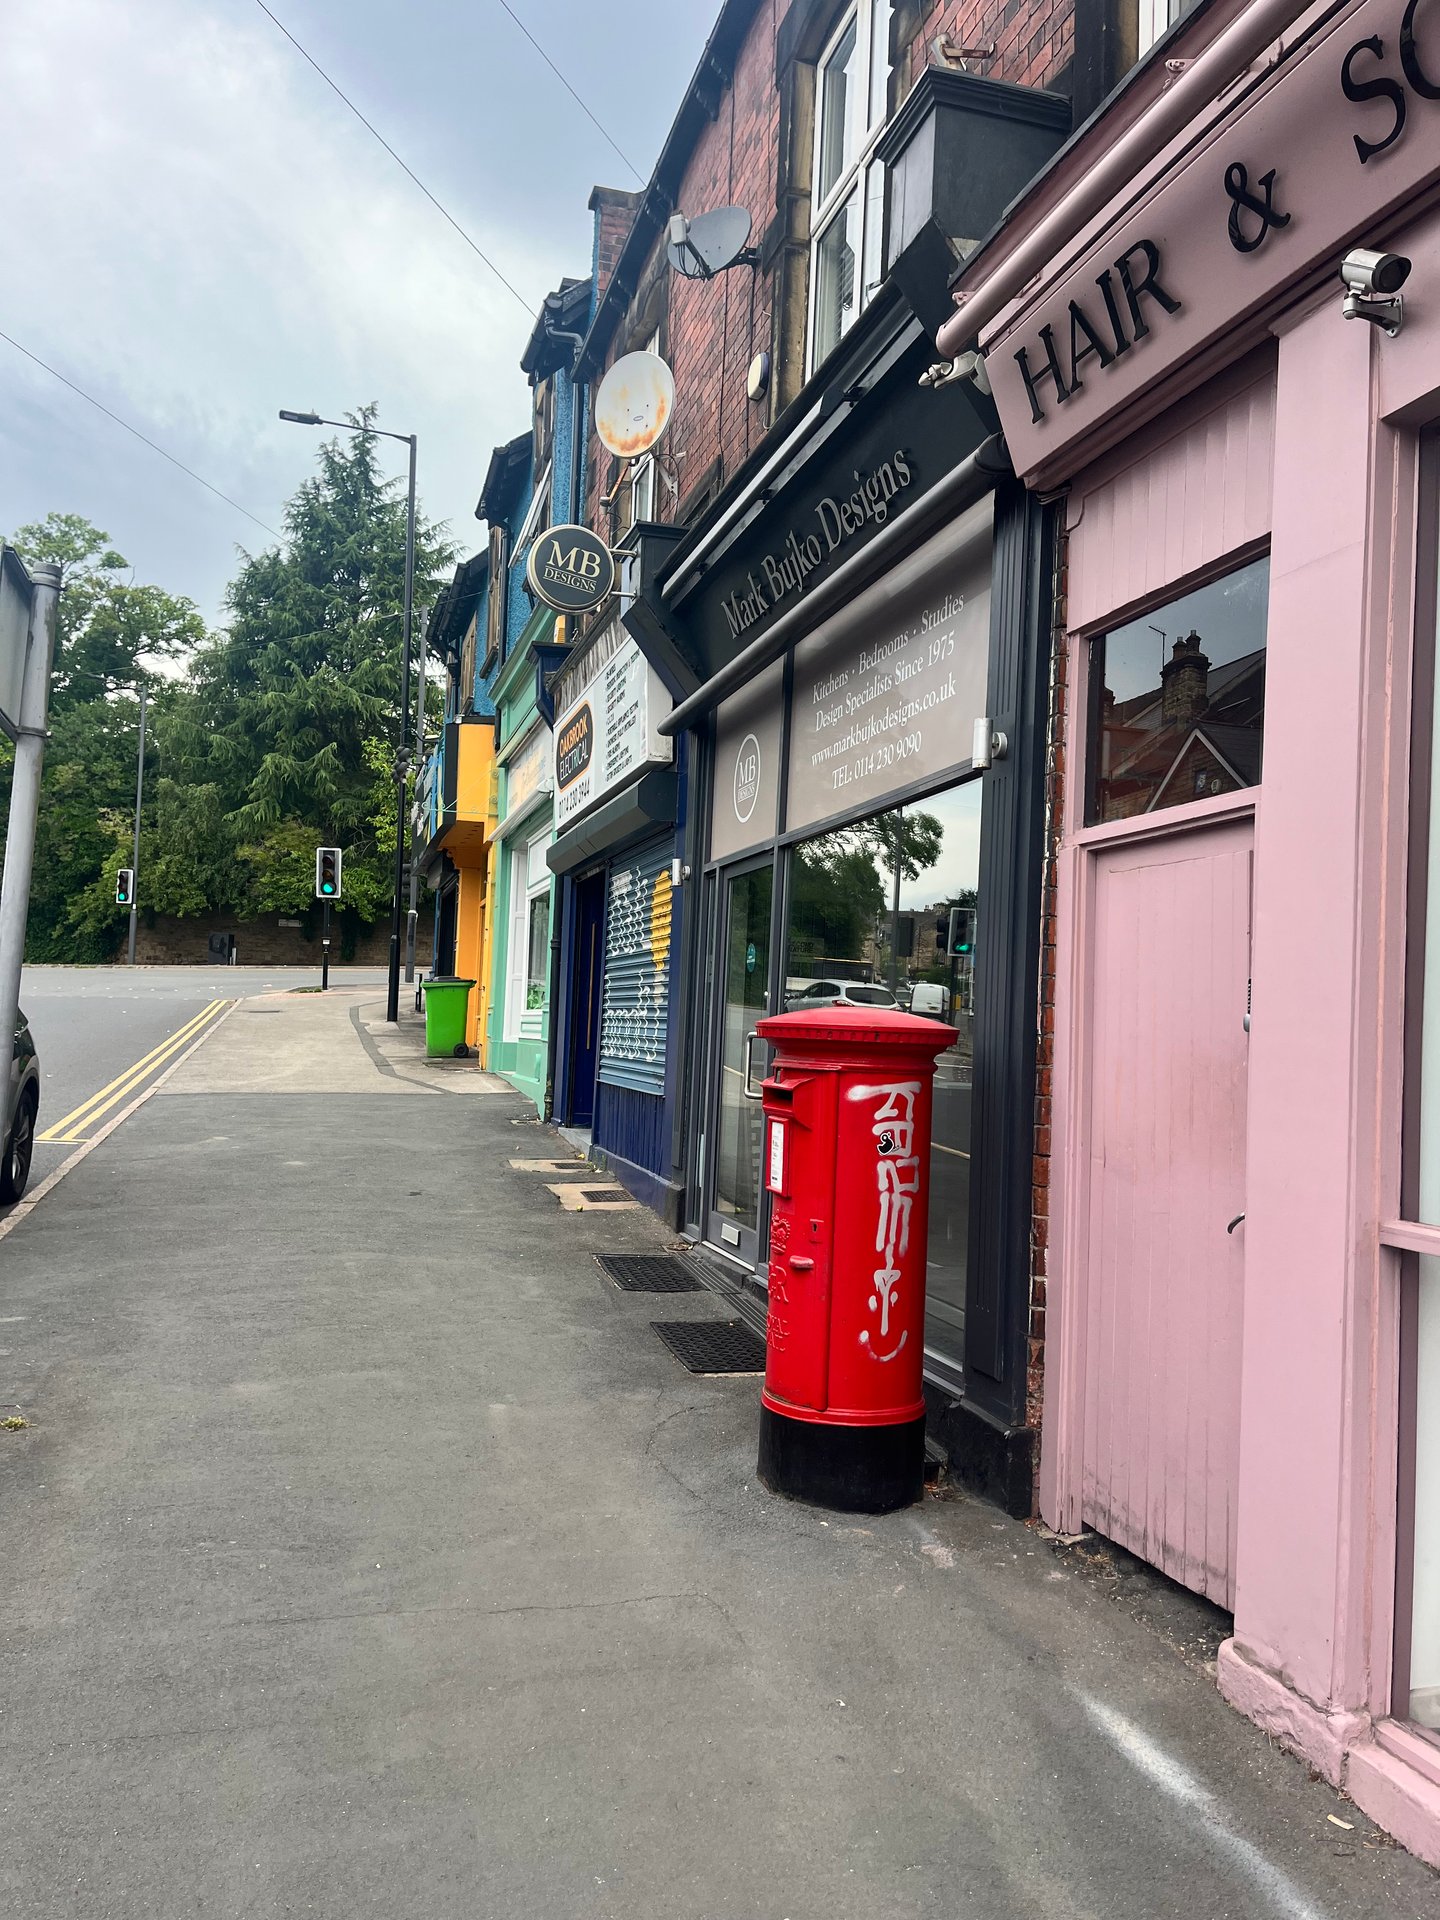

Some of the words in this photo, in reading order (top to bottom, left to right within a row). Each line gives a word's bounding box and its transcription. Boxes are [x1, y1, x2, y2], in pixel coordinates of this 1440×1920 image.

[1014, 239, 1181, 424] HAIR
[1224, 162, 1291, 253] &
[547, 540, 601, 578] MB
[720, 571, 770, 639] Mark
[761, 530, 822, 602] Bujko
[814, 450, 911, 552] Designs
[544, 567, 597, 592] DESIGNS
[813, 669, 849, 704] Kitchens
[859, 629, 909, 675] Bedrooms
[921, 594, 964, 634] Studies
[815, 703, 843, 732] Design
[845, 672, 892, 716] Specialists
[895, 655, 924, 685] Since
[928, 630, 955, 667] 1975
[560, 713, 588, 758] OAKBROOK
[811, 672, 957, 767] www.markbujkodesigns.co.uk
[560, 738, 589, 781] ELECTRICAL
[739, 754, 756, 787] MB
[832, 765, 852, 790] TEL:
[854, 754, 874, 781] 0114
[876, 744, 894, 771] 230
[896, 731, 922, 762] 9090
[737, 783, 755, 801] DESIGNS
